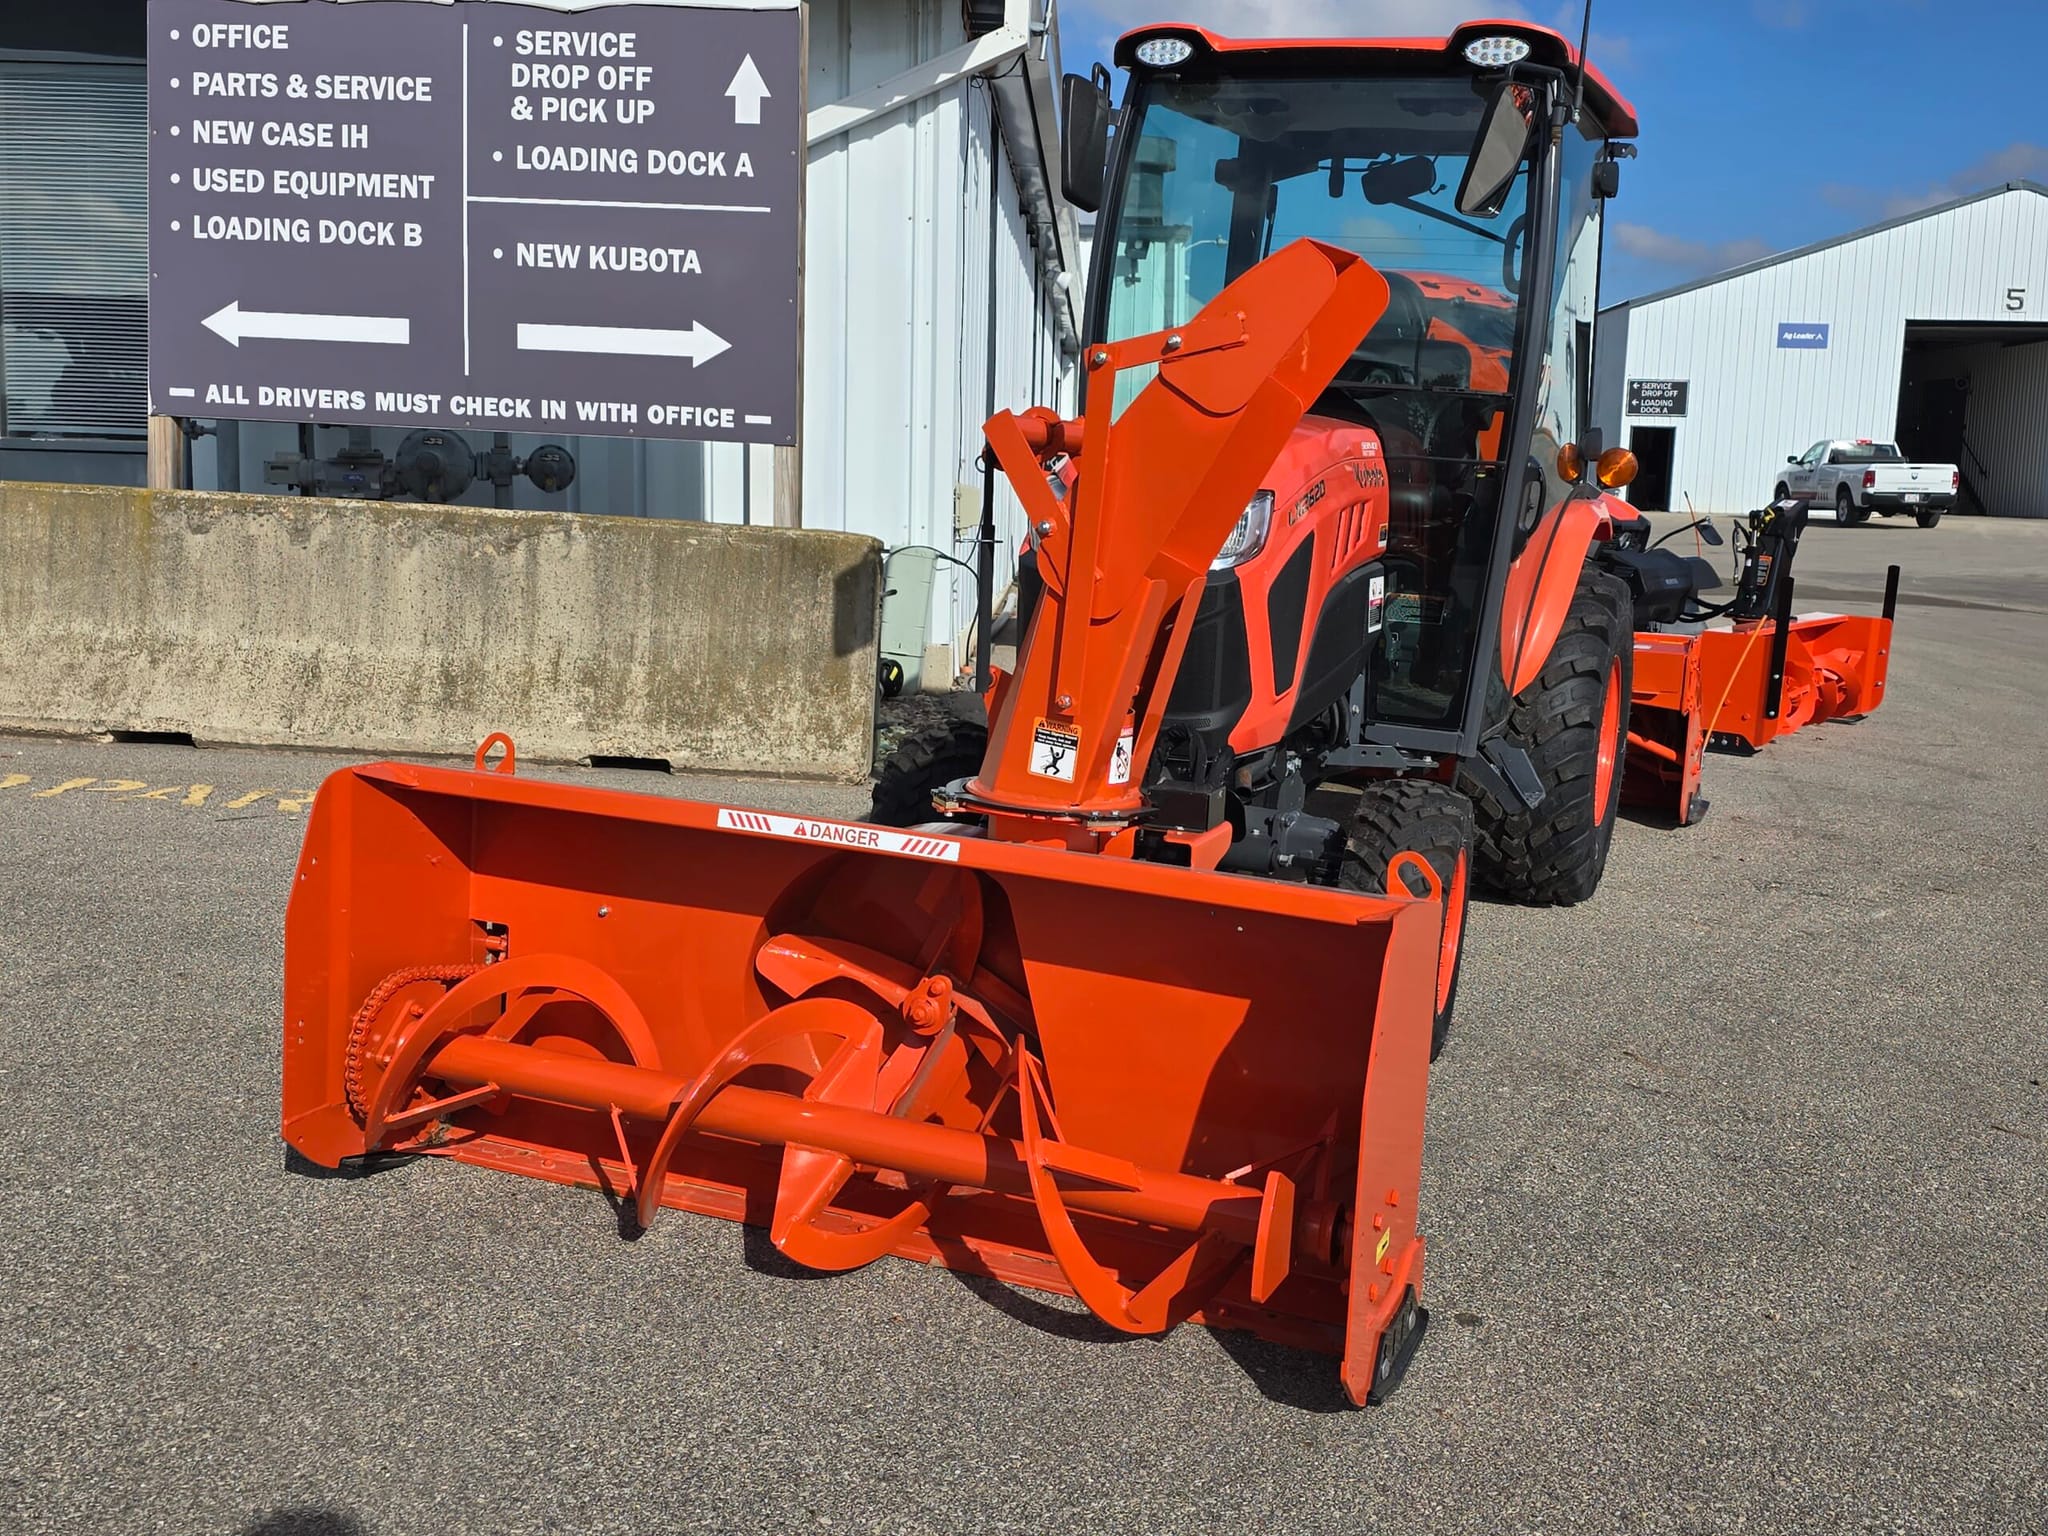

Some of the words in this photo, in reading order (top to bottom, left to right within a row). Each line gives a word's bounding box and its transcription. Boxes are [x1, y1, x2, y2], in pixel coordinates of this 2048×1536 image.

[192, 24, 289, 49] OFFICE
[515, 30, 636, 57] SERVICE
[192, 72, 279, 98] PARTS
[286, 74, 309, 98] &
[314, 75, 432, 101] SERVICE
[511, 63, 590, 89] DROP
[597, 66, 653, 91] OFF
[510, 96, 534, 121] &
[541, 97, 608, 122] PICK
[616, 99, 655, 124] UP
[193, 120, 255, 144] NEW
[261, 122, 334, 147] CASE
[341, 125, 368, 148] IH
[516, 145, 638, 173] LOADING
[647, 150, 727, 176] DOCK
[734, 153, 755, 177] A
[193, 168, 265, 193] USED
[273, 170, 435, 199] EQUIPMENT
[193, 215, 310, 242] LOADING
[318, 220, 396, 245] DOCK
[403, 223, 423, 247] B
[516, 243, 582, 268] NEW
[589, 246, 702, 274] KUBOTA
[2006, 288, 2026, 310] 5
[205, 384, 250, 405] ALL
[258, 386, 366, 410] DRIVERS
[375, 392, 442, 414] MUST
[449, 396, 532, 418] CHECK
[541, 400, 566, 419] IN
[575, 401, 638, 423] WITH
[647, 405, 735, 428] OFFICE
[1640, 406, 1661, 414] DOCK
[1046, 721, 1078, 735] WARNING
[810, 823, 879, 847] DANGER
